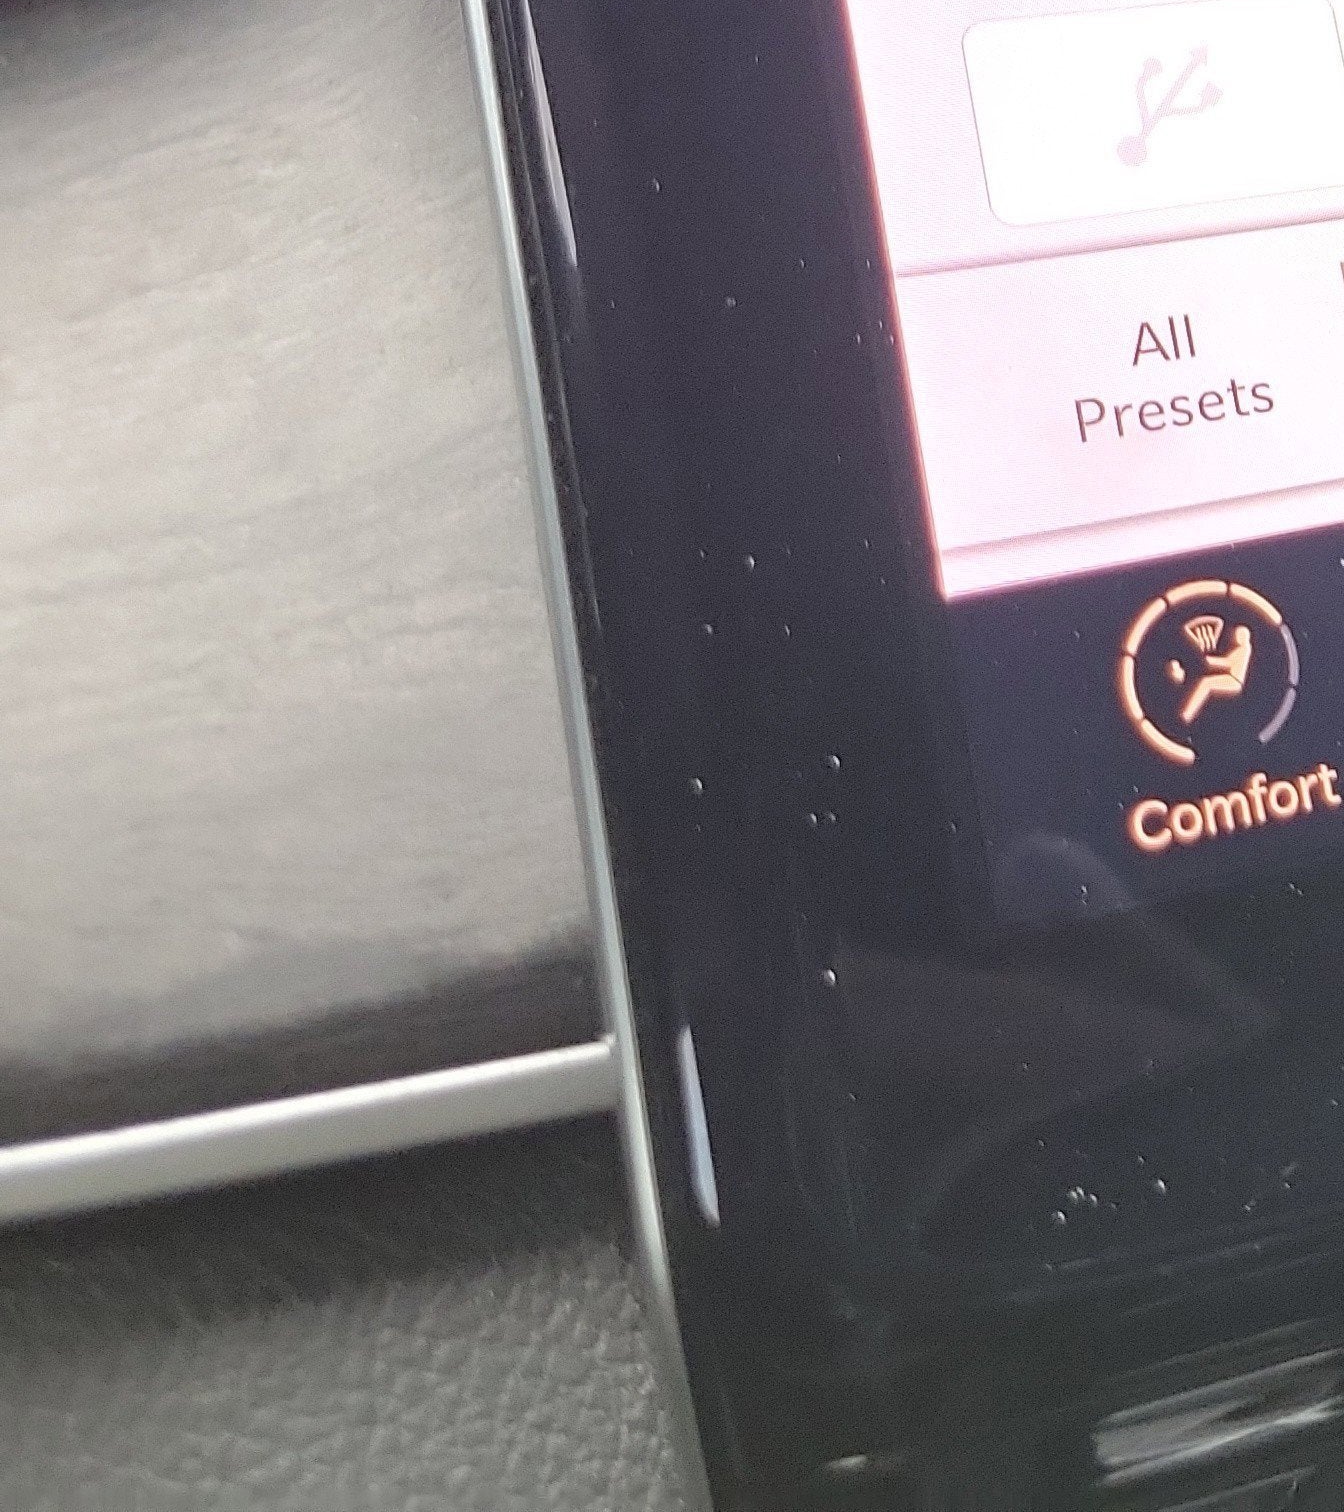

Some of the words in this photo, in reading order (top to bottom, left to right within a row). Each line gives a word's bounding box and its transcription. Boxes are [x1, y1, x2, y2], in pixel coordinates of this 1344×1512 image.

[1131, 313, 1197, 368] All
[1074, 375, 1276, 445] Presets
[1129, 762, 1343, 853] Comfort
